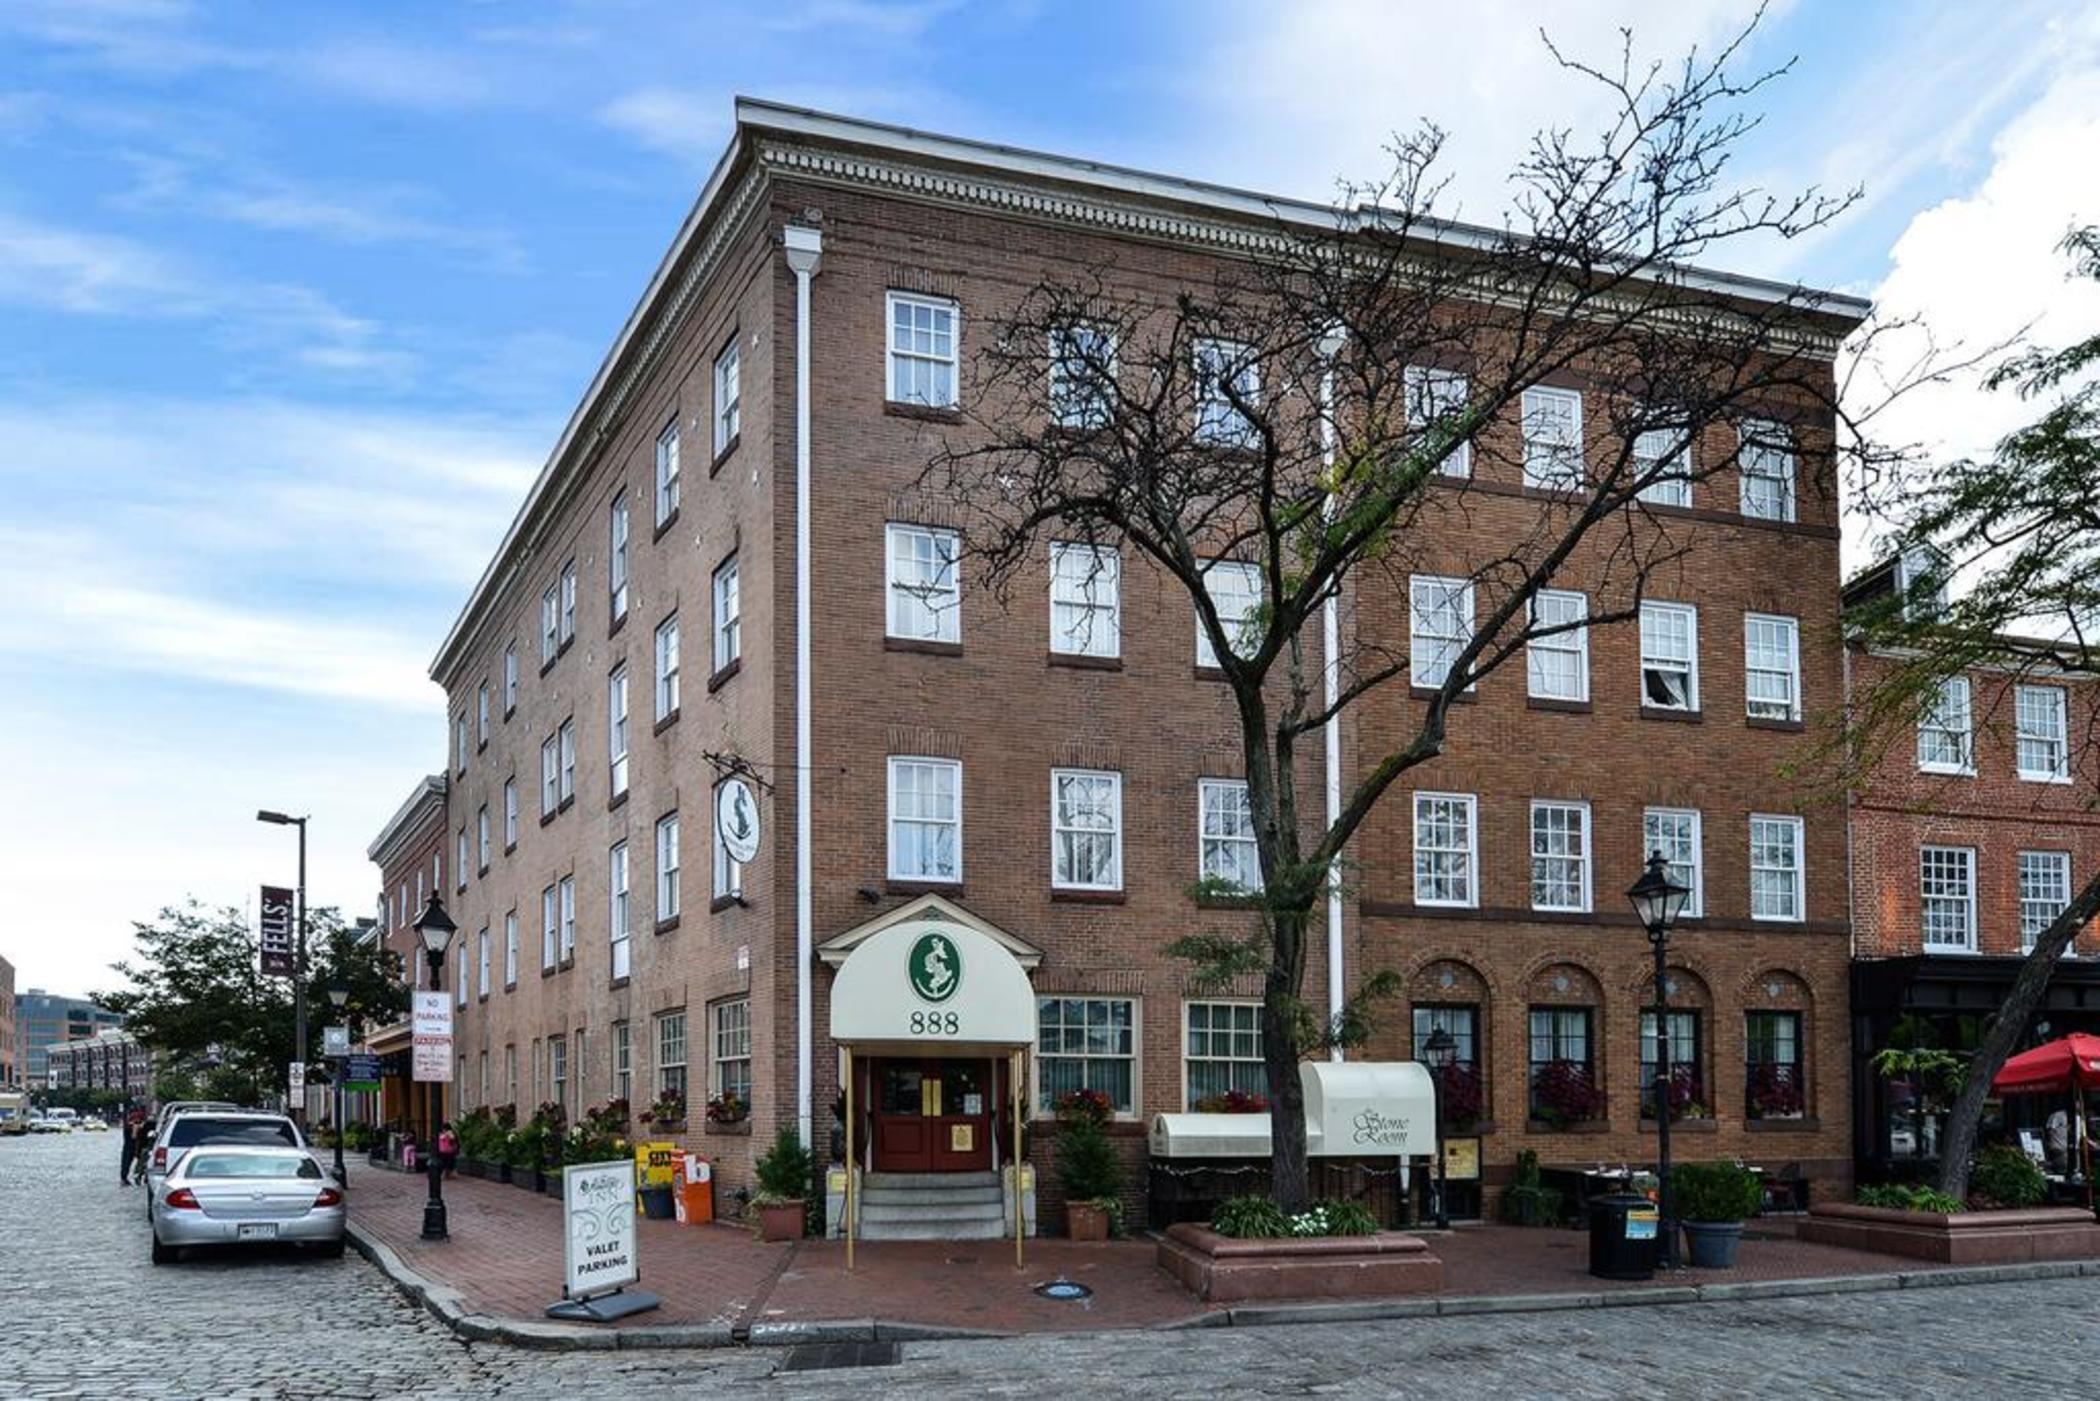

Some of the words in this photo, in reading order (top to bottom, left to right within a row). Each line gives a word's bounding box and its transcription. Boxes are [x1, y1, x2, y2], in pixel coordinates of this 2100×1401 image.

[911, 1011, 958, 1035] 888
[1353, 1112, 1409, 1131] Stone
[1353, 1130, 1408, 1145] Room
[586, 1240, 620, 1257] VALET
[578, 1255, 628, 1275] PARKING
